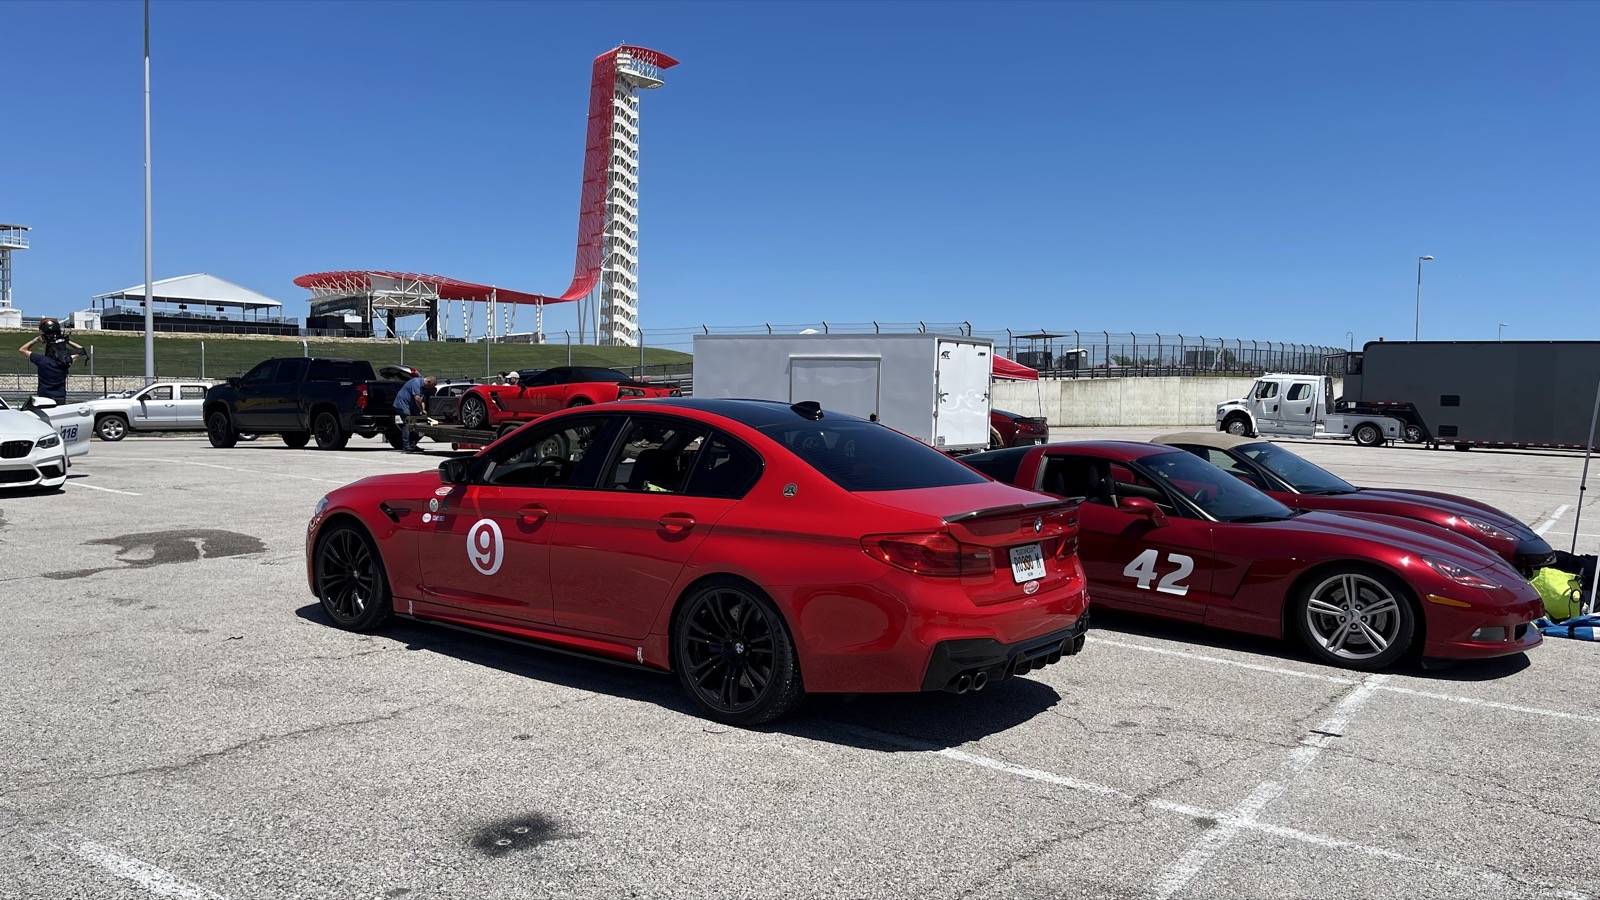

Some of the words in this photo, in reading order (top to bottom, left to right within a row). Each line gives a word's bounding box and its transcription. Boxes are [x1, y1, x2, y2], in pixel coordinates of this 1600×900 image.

[62, 427, 77, 439] 118
[474, 524, 496, 570] 9
[1123, 549, 1194, 596] 42
